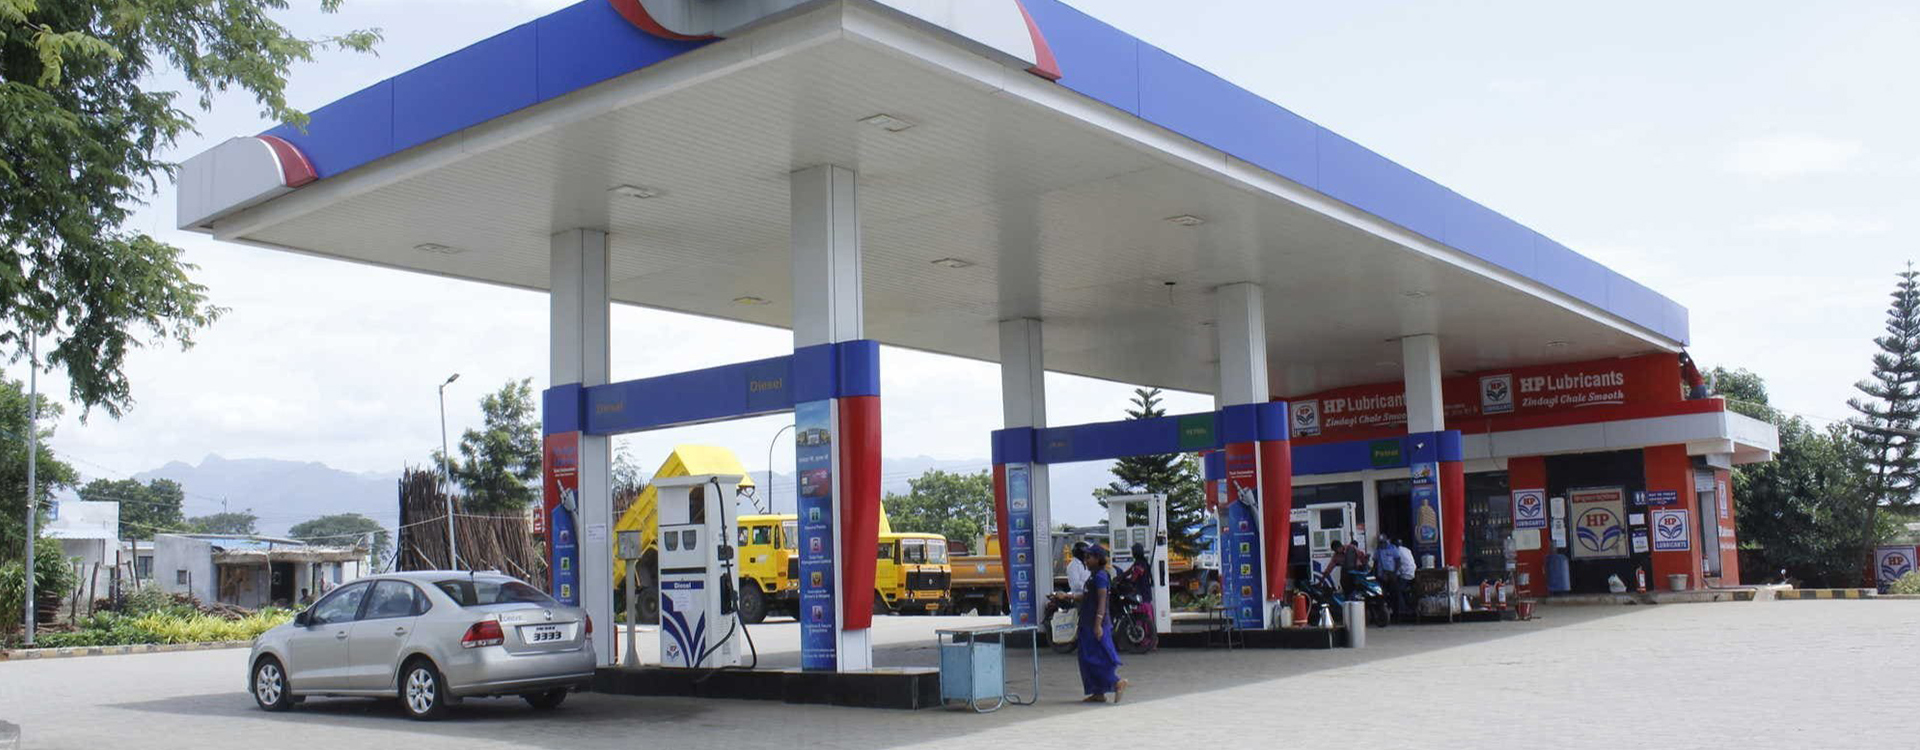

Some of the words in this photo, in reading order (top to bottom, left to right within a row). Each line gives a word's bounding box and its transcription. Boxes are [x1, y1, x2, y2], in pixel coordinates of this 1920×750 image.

[750, 379, 782, 392] Diesel
[1520, 378, 1545, 392] HP
[1547, 371, 1624, 391] Lubricants
[1323, 399, 1346, 414] HP
[1348, 393, 1408, 412] Lubricant
[1521, 396, 1559, 407] Zindagi
[1560, 394, 1586, 404] Chale
[1587, 390, 1624, 401] Smooth
[1326, 416, 1357, 427] Zindagi
[1359, 414, 1382, 424] Chale
[1586, 513, 1609, 526] HP
[533, 631, 561, 641] 3333
